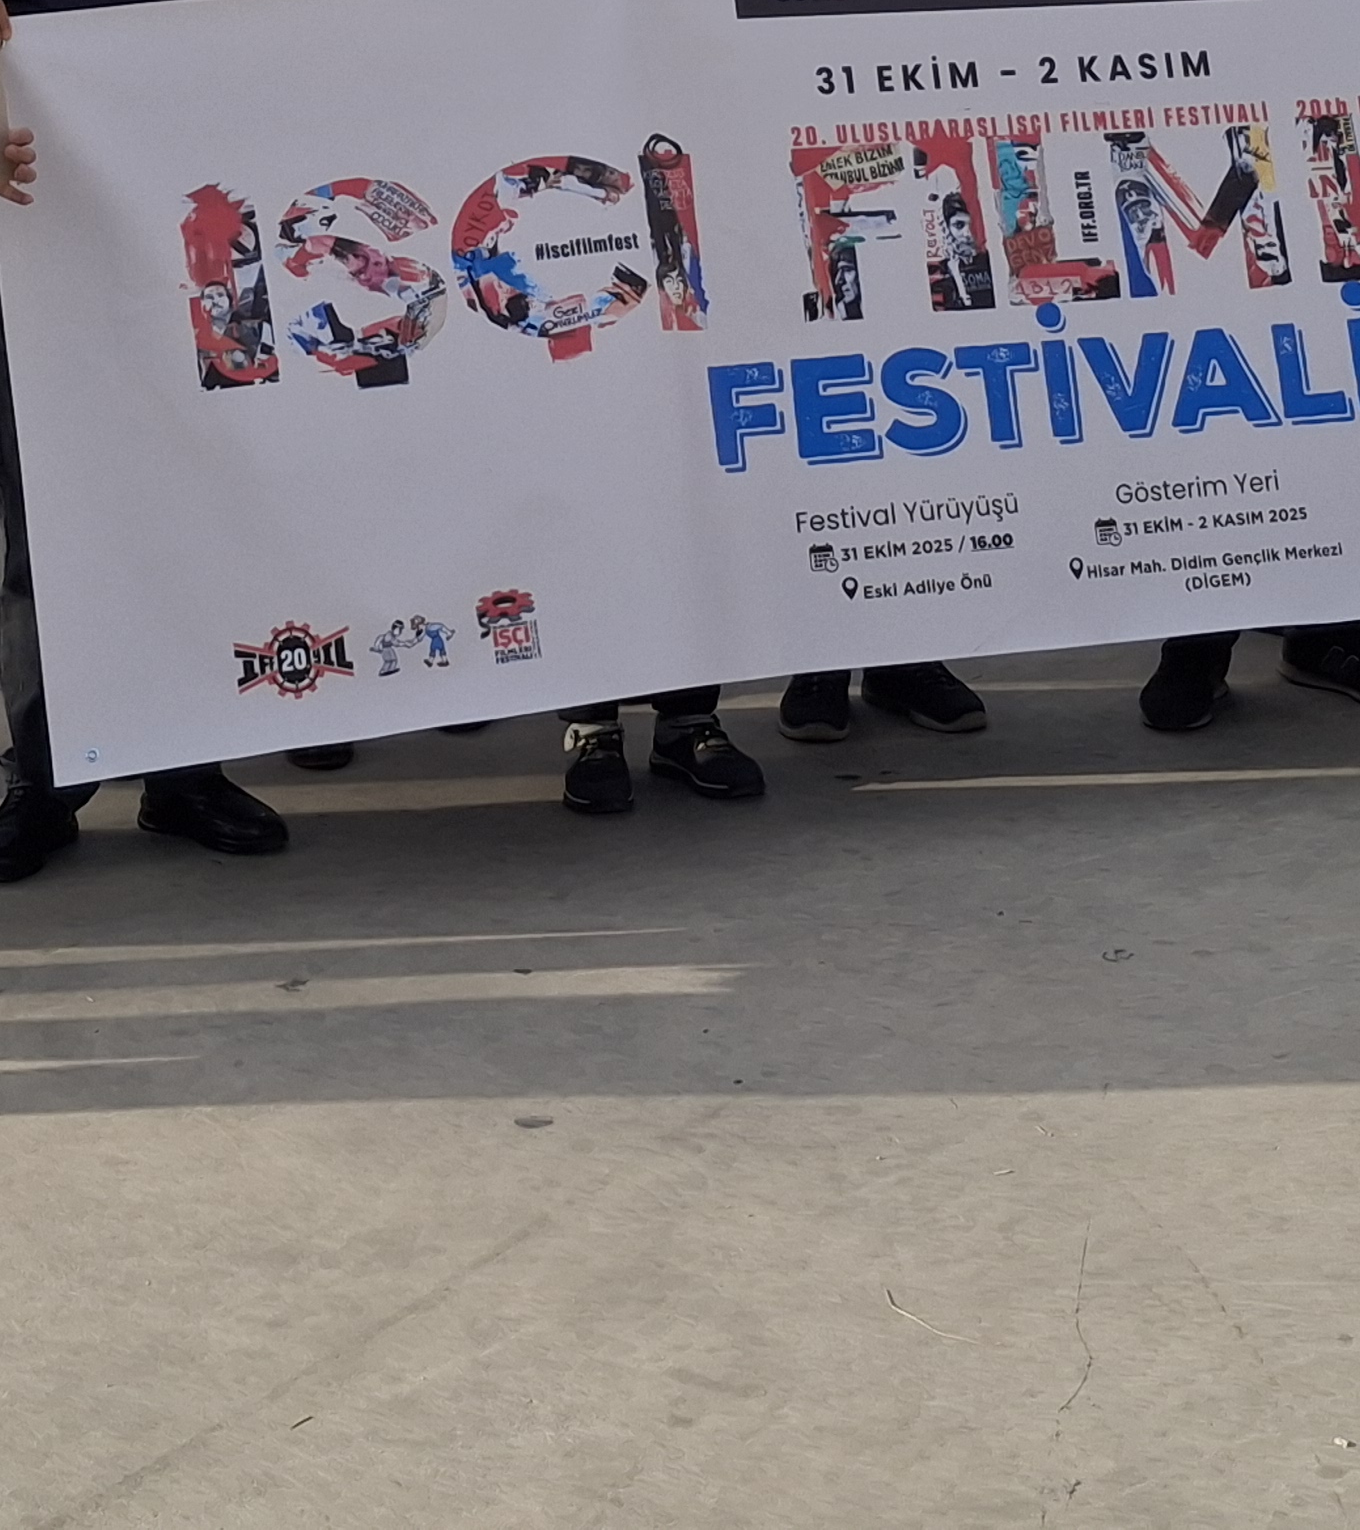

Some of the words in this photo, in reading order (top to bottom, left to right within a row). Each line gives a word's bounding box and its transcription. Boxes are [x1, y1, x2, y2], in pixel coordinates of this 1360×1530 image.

[815, 64, 855, 95] 31
[877, 55, 979, 93] EKİM
[1038, 56, 1059, 85] 2
[1077, 50, 1212, 84] KASIM
[1296, 97, 1348, 119] 20th
[791, 124, 827, 147] 20.
[836, 115, 998, 145] ULUSLARARASI
[1115, 476, 1228, 504] Gösterim
[1233, 469, 1280, 494] Yeri
[796, 501, 896, 533] Festival
[903, 492, 1019, 525] Yürüyüşü
[1123, 522, 1139, 537] 31
[1143, 516, 1183, 534] EKİM
[1198, 516, 1209, 530] 2
[1213, 511, 1264, 528] KASIM
[1268, 506, 1308, 523] 2025
[841, 547, 858, 562] 31
[863, 541, 907, 560] EKİM
[911, 538, 953, 555] 2025
[958, 535, 966, 554] /
[970, 532, 1015, 550] 16.00
[1086, 563, 1125, 579] Hisar
[1130, 558, 1167, 575] Mah.
[1170, 553, 1218, 572] Didim
[1222, 547, 1282, 568] Gençlik
[1284, 541, 1344, 561] Merkezi
[863, 581, 898, 600] Eski
[903, 578, 956, 596] Adliye
[960, 573, 993, 590] Önü
[1185, 571, 1252, 592] (DİGEM)
